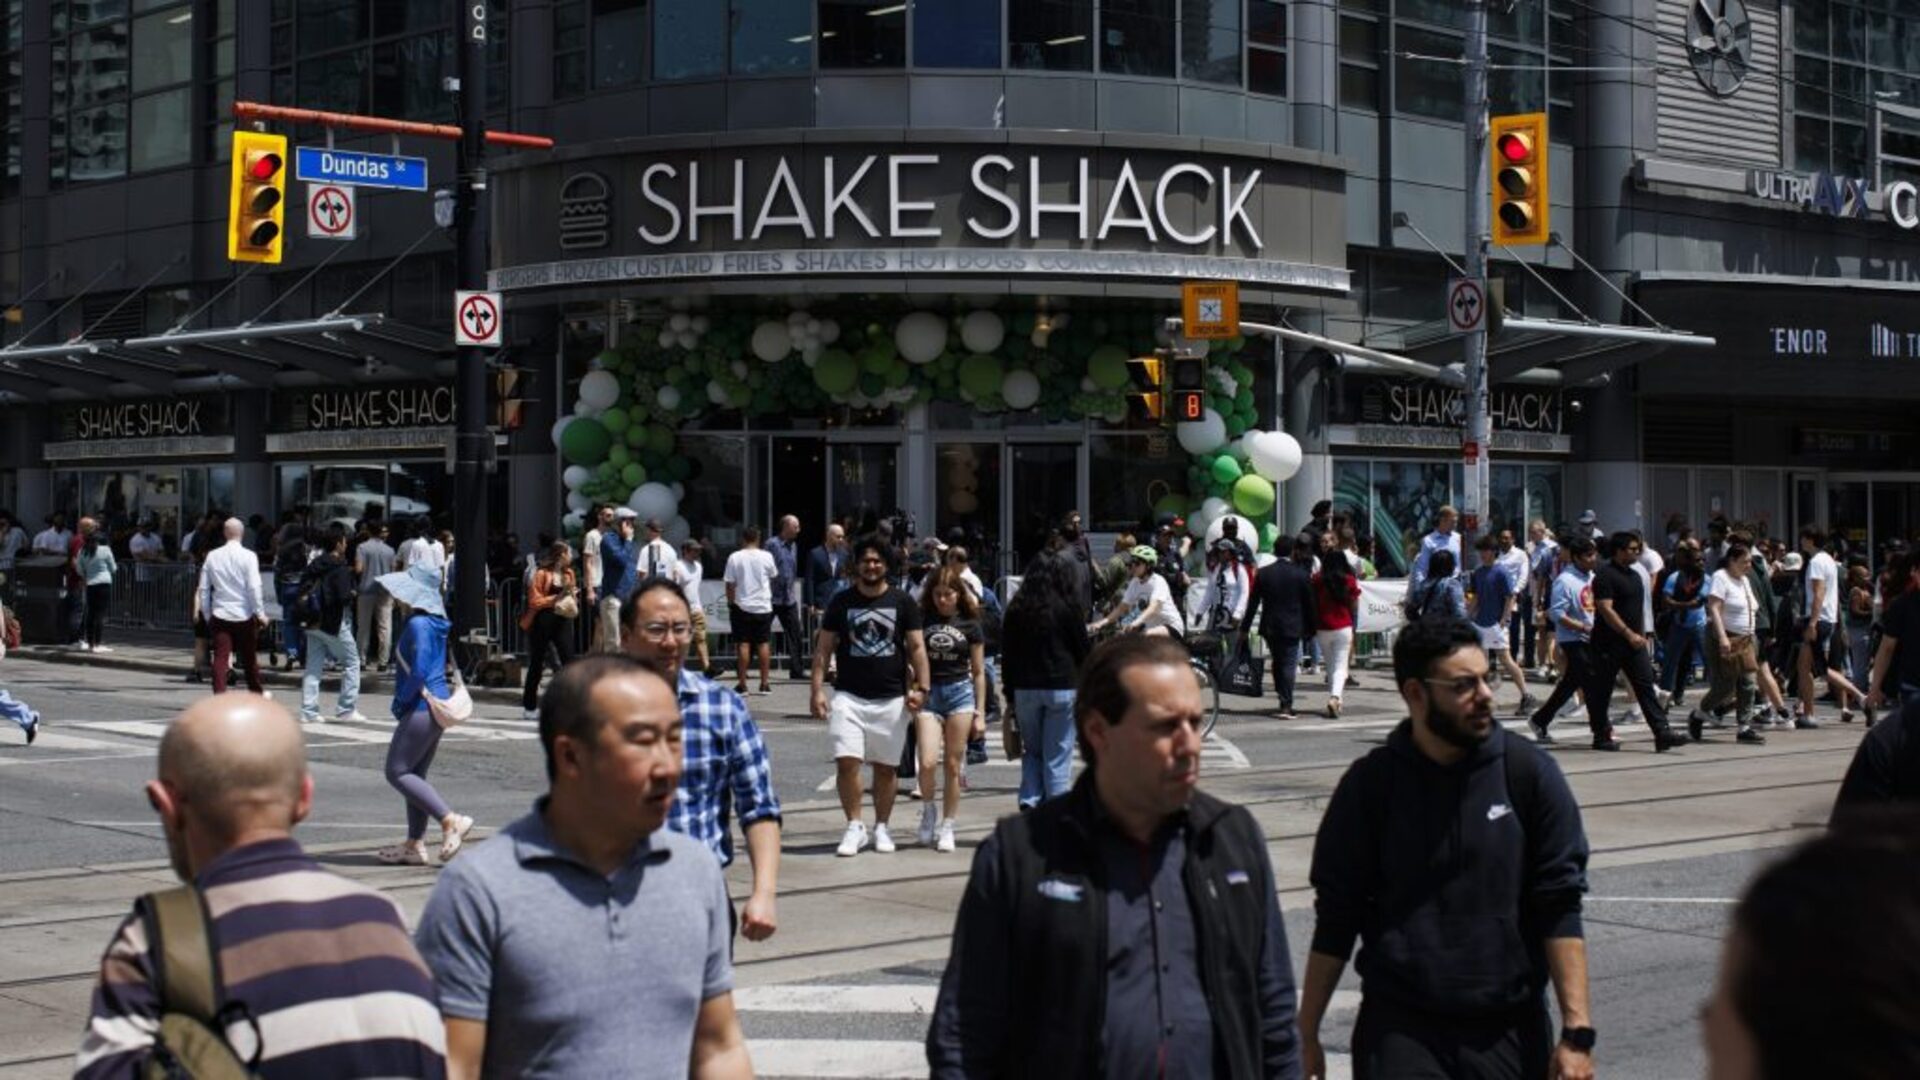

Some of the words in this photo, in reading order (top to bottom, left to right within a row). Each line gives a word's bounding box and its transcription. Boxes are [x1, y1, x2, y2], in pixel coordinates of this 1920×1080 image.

[321, 153, 389, 179] Dundas
[638, 155, 940, 245] SHAKE
[967, 154, 1263, 249] SHACK
[496, 269, 550, 288] BURGERS
[554, 259, 620, 281] FROZEN
[623, 254, 713, 277] CUSTARD
[723, 254, 783, 272] FRIES
[795, 251, 888, 271] SHAKES
[900, 250, 948, 270] HOT
[957, 251, 1027, 270] DOGS
[1769, 327, 1828, 354] ENOR
[79, 404, 136, 439] SHAKE
[138, 401, 201, 435] SHACK
[310, 391, 383, 429] SHAKE
[1187, 394, 1200, 418] 8
[1390, 385, 1464, 427] SHAK
[1487, 391, 1552, 429] HACK
